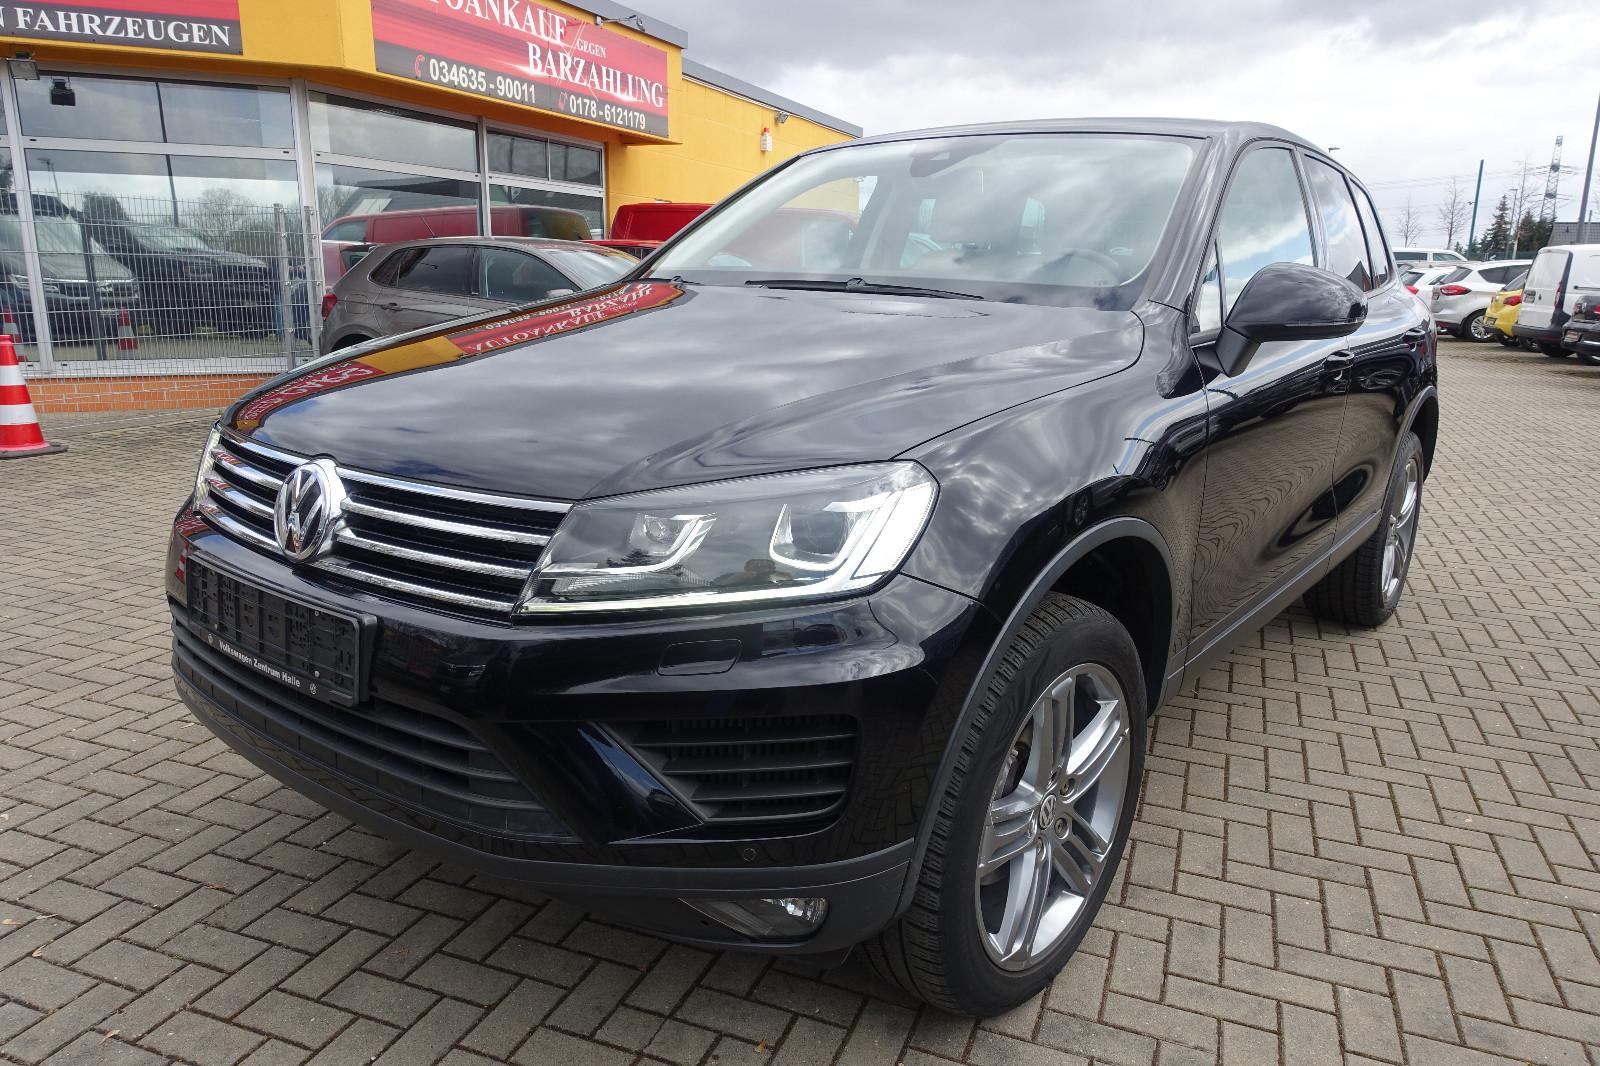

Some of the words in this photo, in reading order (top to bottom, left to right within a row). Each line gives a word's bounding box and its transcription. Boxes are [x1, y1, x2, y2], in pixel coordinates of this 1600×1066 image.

[14, 7, 231, 47] FAHRZEUGEN
[576, 38, 607, 59] GEGEN
[527, 41, 664, 107] BARZAHLUNG
[219, 639, 253, 666] Volkswagen
[253, 657, 281, 679] Zentrum
[281, 671, 301, 687] Halle
